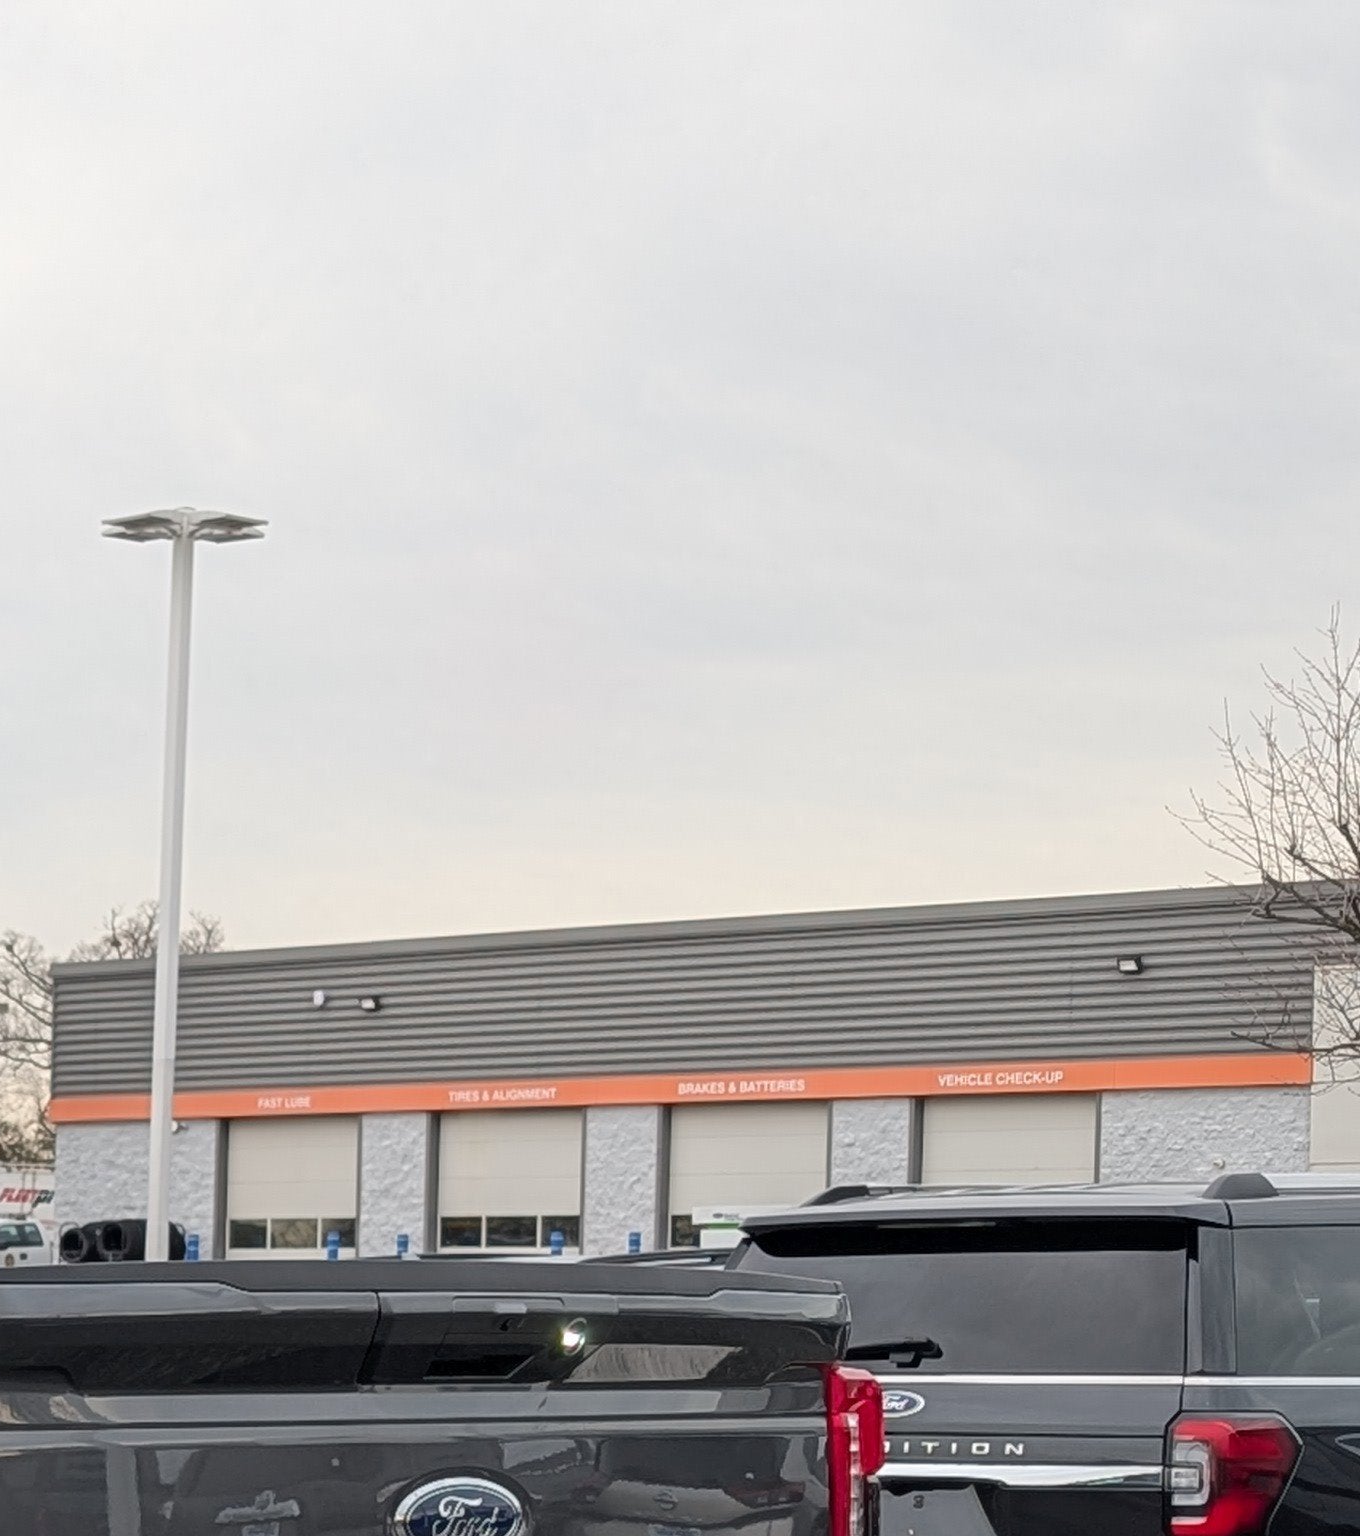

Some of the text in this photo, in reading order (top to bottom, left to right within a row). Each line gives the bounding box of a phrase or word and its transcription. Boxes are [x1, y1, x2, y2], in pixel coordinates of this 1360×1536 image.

[678, 1078, 806, 1095] BRAKES & BATTERIES
[938, 1070, 1064, 1087] VEHICLE CHECK-UP
[257, 1095, 311, 1110] FAST LUBE
[448, 1088, 557, 1103] TIRES & ALIGNMENT
